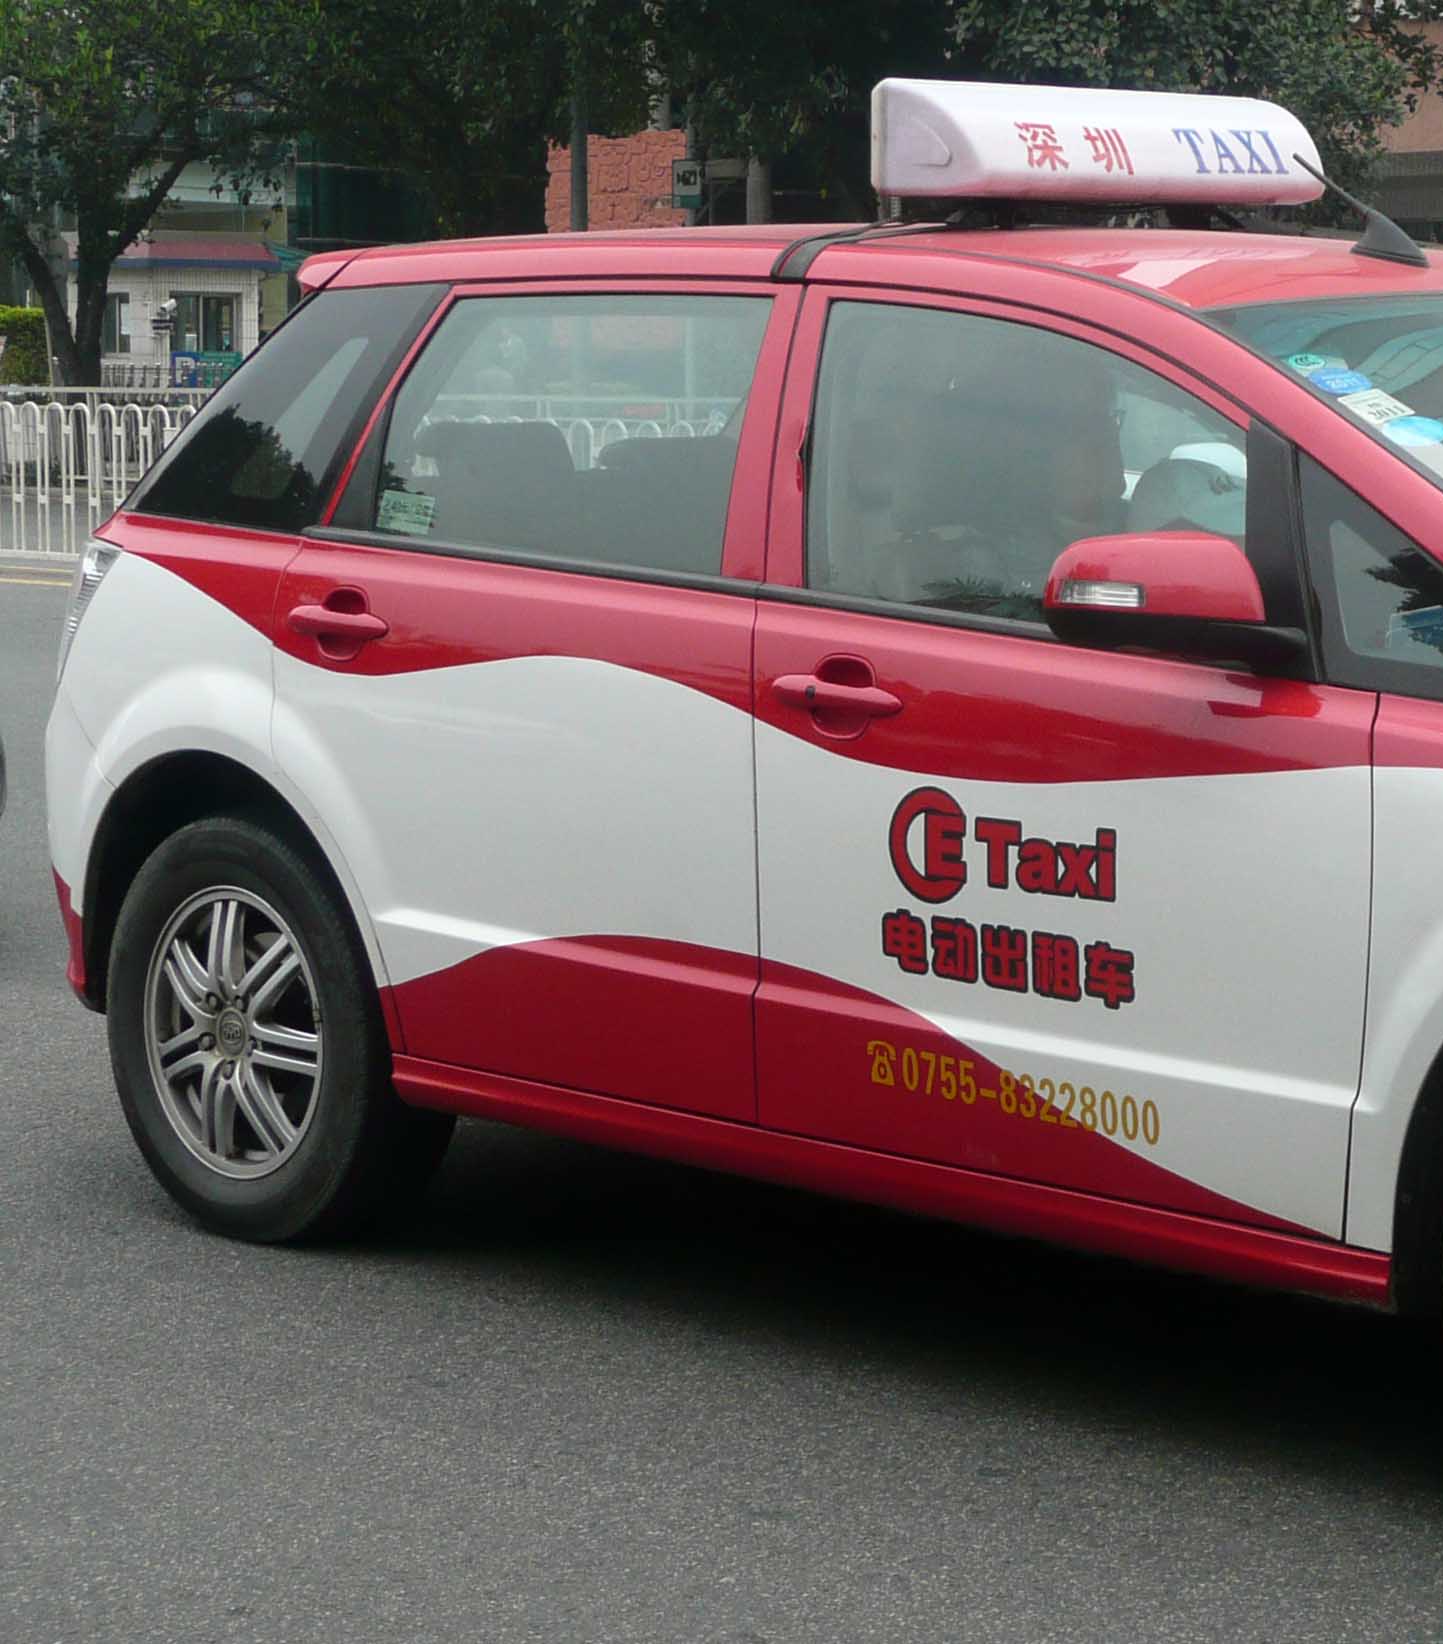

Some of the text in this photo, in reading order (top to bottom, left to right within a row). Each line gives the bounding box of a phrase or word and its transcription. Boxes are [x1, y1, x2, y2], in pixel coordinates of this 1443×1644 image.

[1014, 121, 1134, 176] 深圳
[1172, 128, 1290, 175] TAXI
[974, 816, 1117, 902] Taxi
[881, 909, 1135, 1010] 电动出租车
[902, 1047, 1161, 1146] 0755-83228000
